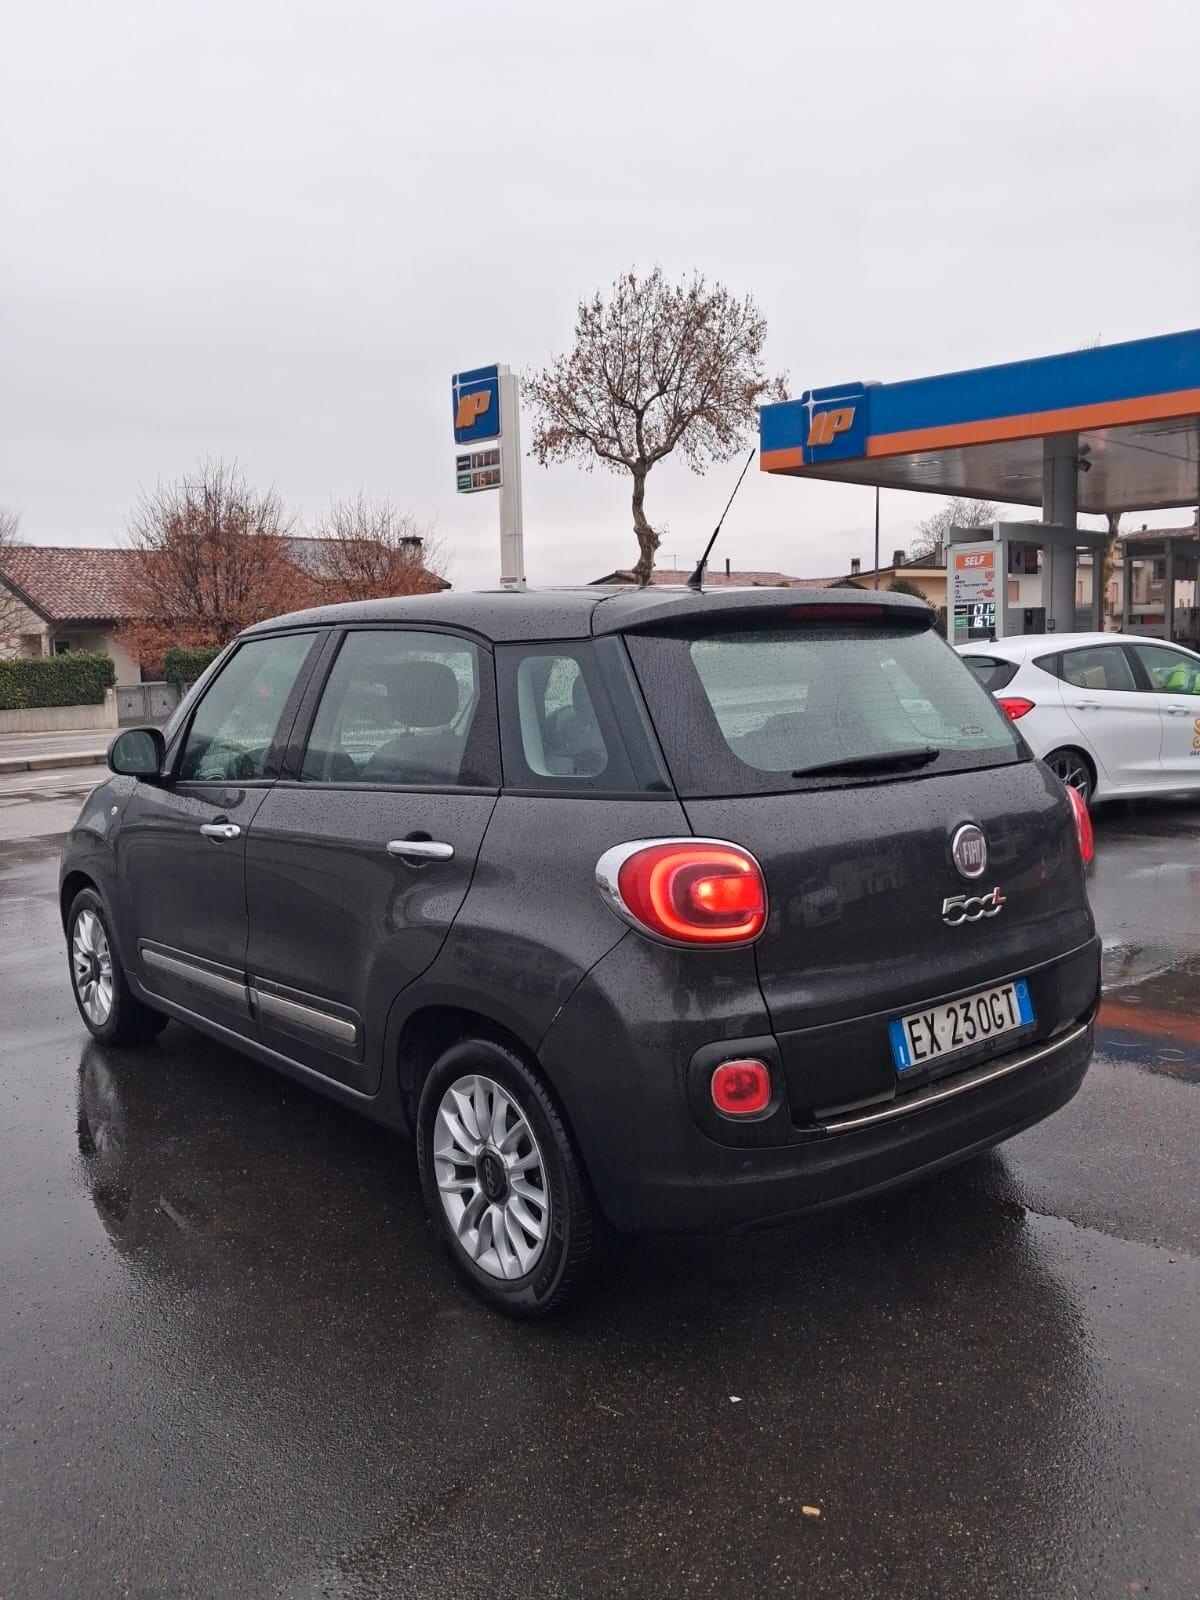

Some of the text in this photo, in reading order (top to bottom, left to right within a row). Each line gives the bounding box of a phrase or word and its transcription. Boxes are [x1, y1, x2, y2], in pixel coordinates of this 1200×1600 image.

[455, 389, 491, 428] IP
[807, 407, 856, 447] IP
[964, 555, 985, 566] SELF
[962, 839, 983, 865] FIAT
[942, 887, 1007, 926] 500L
[907, 988, 1015, 1060] EX 230GT
